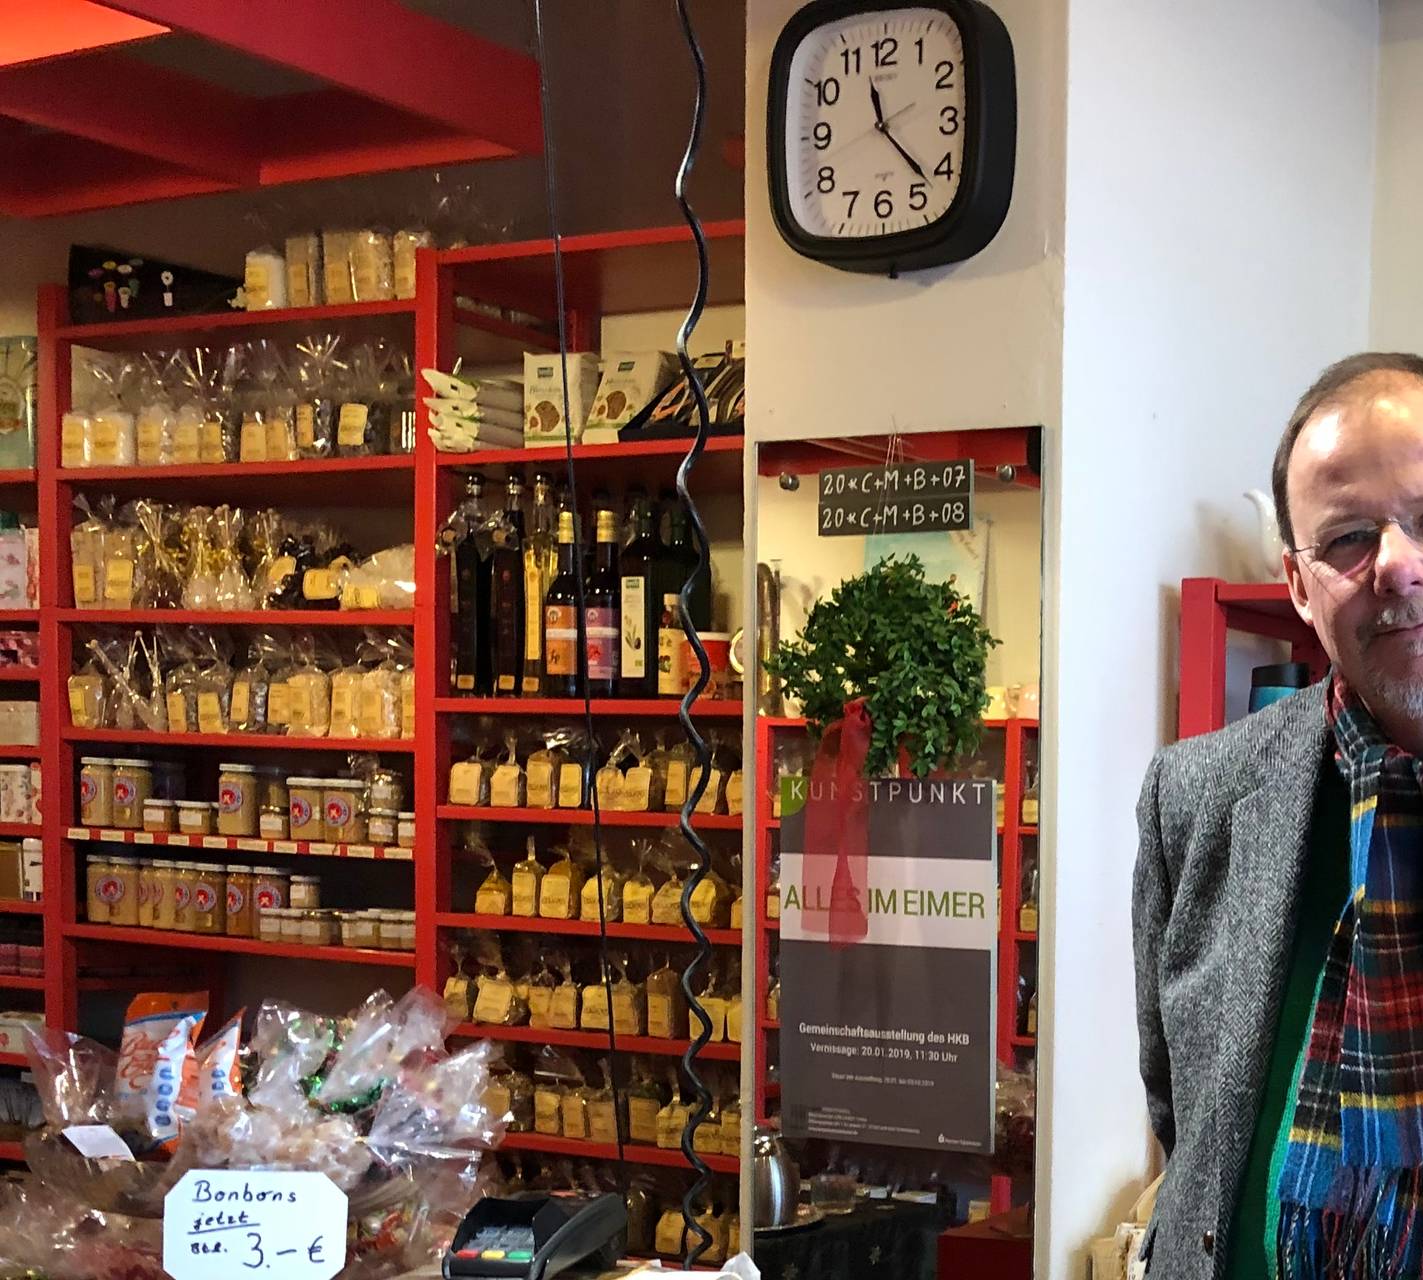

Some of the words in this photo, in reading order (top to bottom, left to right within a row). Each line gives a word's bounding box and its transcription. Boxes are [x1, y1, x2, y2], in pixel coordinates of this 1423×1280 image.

[840, 48, 861, 75] 11
[871, 38, 898, 67] 12
[914, 38, 924, 64] 1
[935, 61, 954, 89] 2
[814, 77, 840, 106] 10
[939, 106, 958, 135] 3
[813, 122, 832, 150] 9
[817, 166, 835, 194] 8
[933, 152, 953, 181] 4
[842, 191, 860, 218] 7
[874, 190, 893, 218] 6
[909, 183, 928, 210] 5
[868, 888, 897, 915] IM
[903, 888, 985, 919] EIMER
[799, 1022, 925, 1044] Gemeinschaftsausstellung
[927, 1031, 945, 1044] des
[947, 1032, 970, 1046] HKB
[810, 1042, 860, 1057] Vernissage:
[861, 1045, 913, 1061] 20.01.2019,
[914, 1049, 940, 1062] 11:30
[941, 1052, 958, 1063] Uhr
[191, 1179, 297, 1203] Bonbons
[193, 1211, 249, 1232] jetzt
[307, 1235, 325, 1263] €
